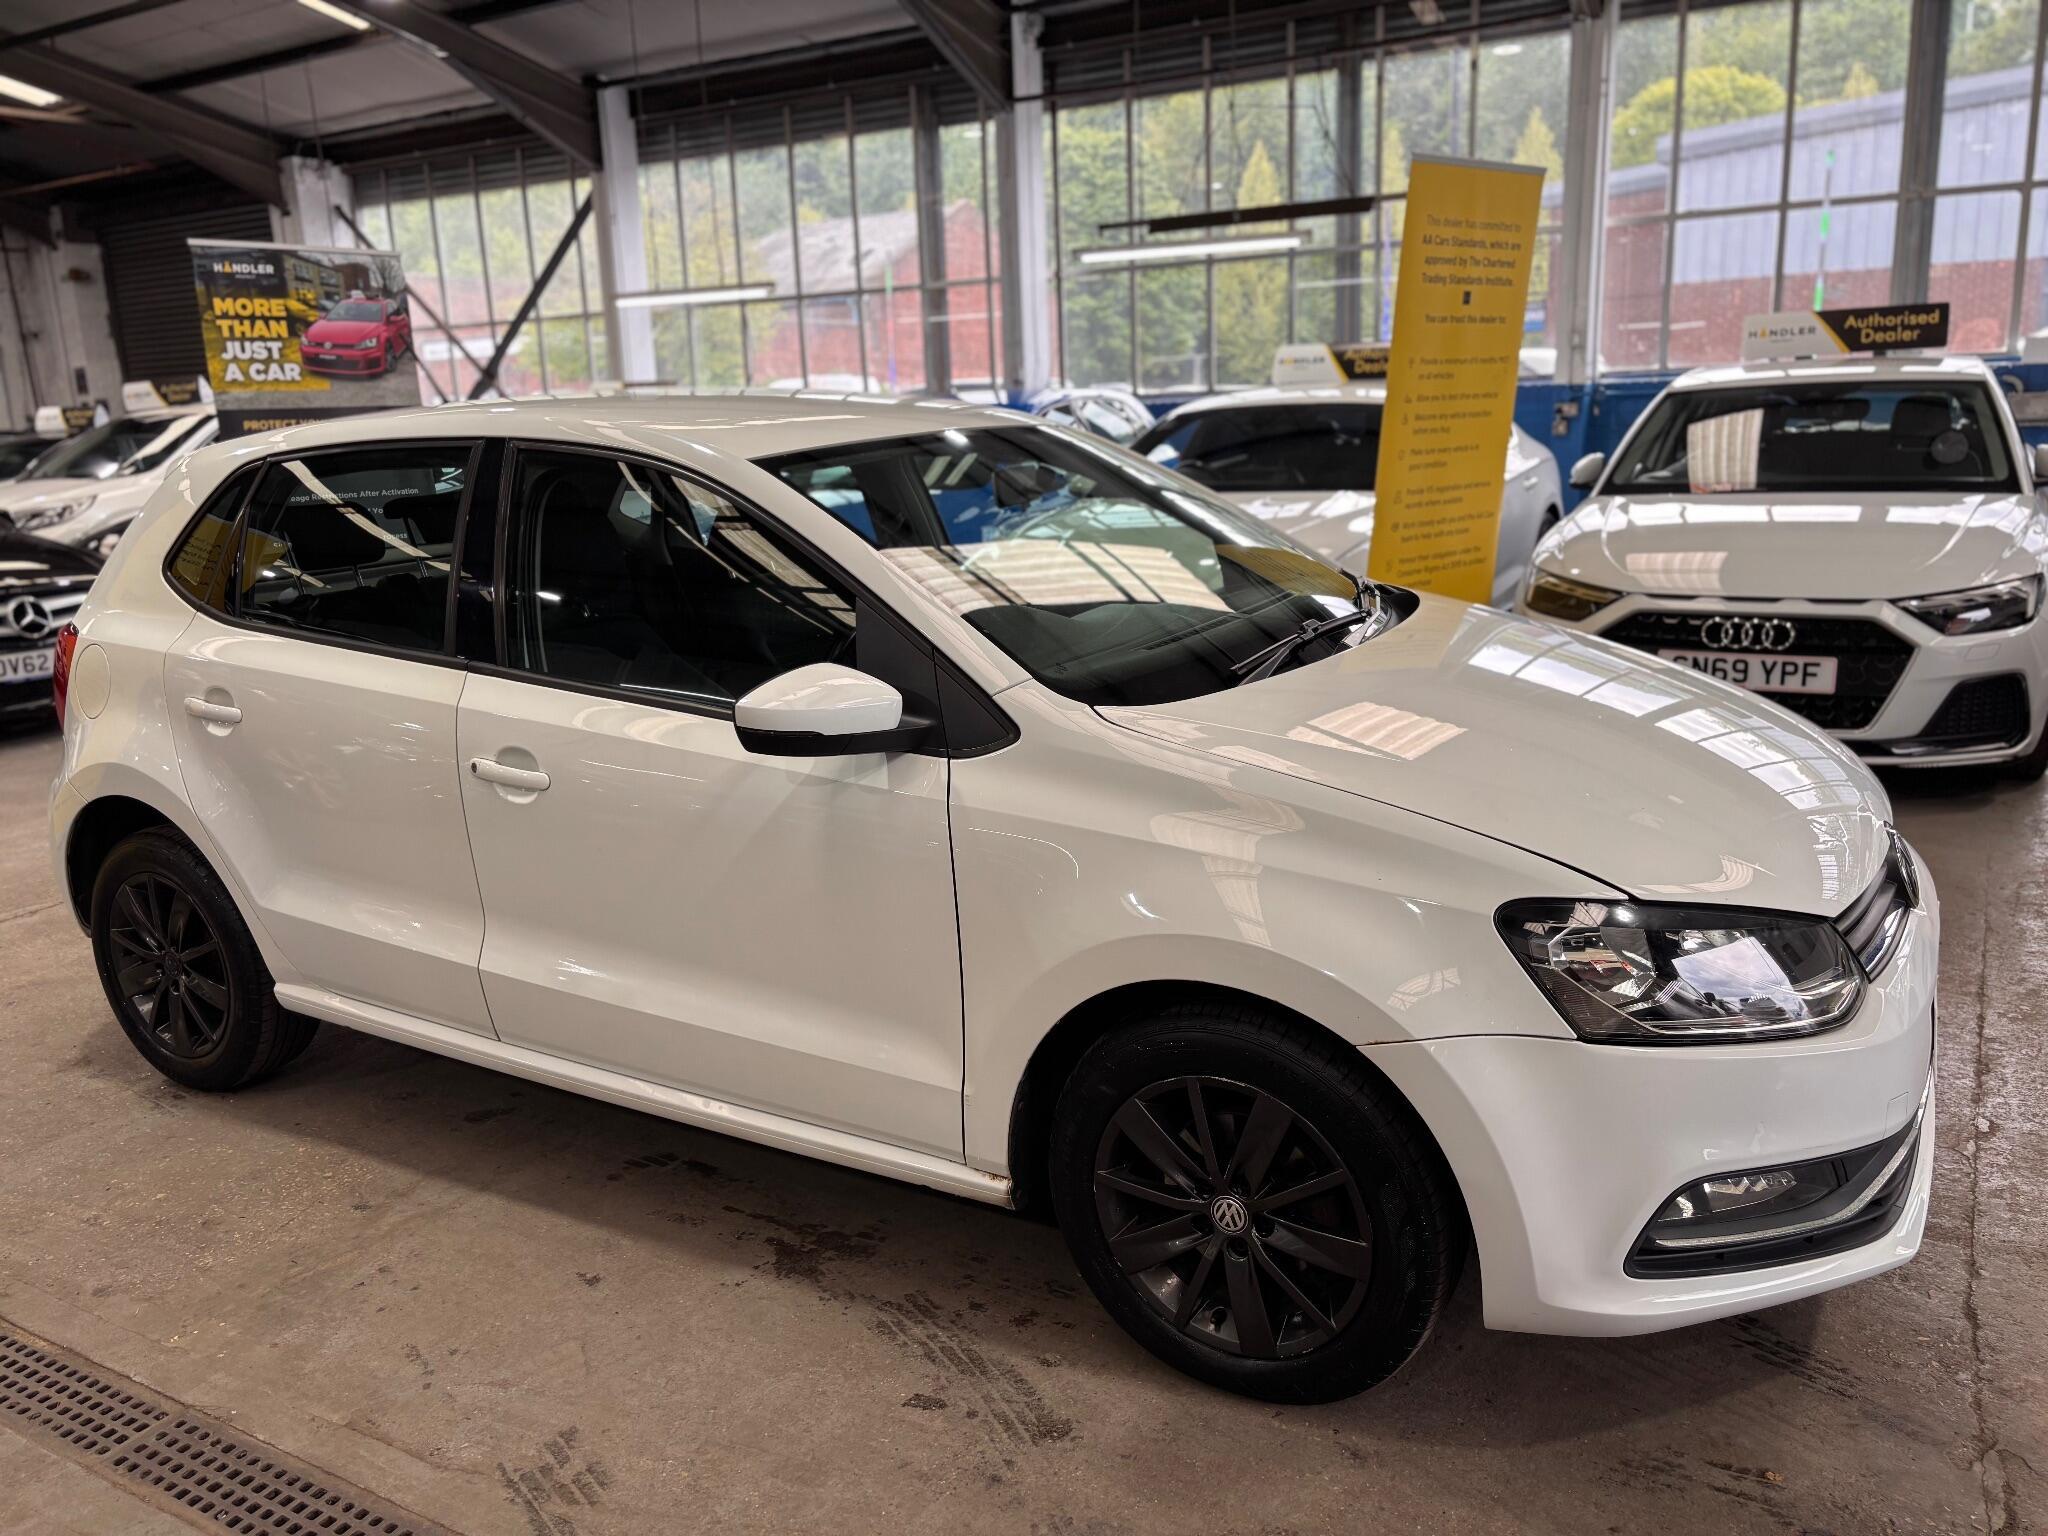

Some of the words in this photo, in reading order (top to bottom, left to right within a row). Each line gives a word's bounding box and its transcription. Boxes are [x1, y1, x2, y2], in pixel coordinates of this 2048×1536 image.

[213, 297, 287, 317] MORE
[216, 319, 289, 338] THAN
[1844, 309, 1940, 329] Authorised
[1861, 326, 1920, 343] Dealer
[222, 340, 283, 360] JUST
[225, 362, 246, 382] A
[248, 362, 302, 382] CAR
[243, 418, 299, 432] PROTECT
[360, 489, 380, 498] After
[381, 487, 419, 497] Activation
[1760, 660, 1821, 686] YPF
